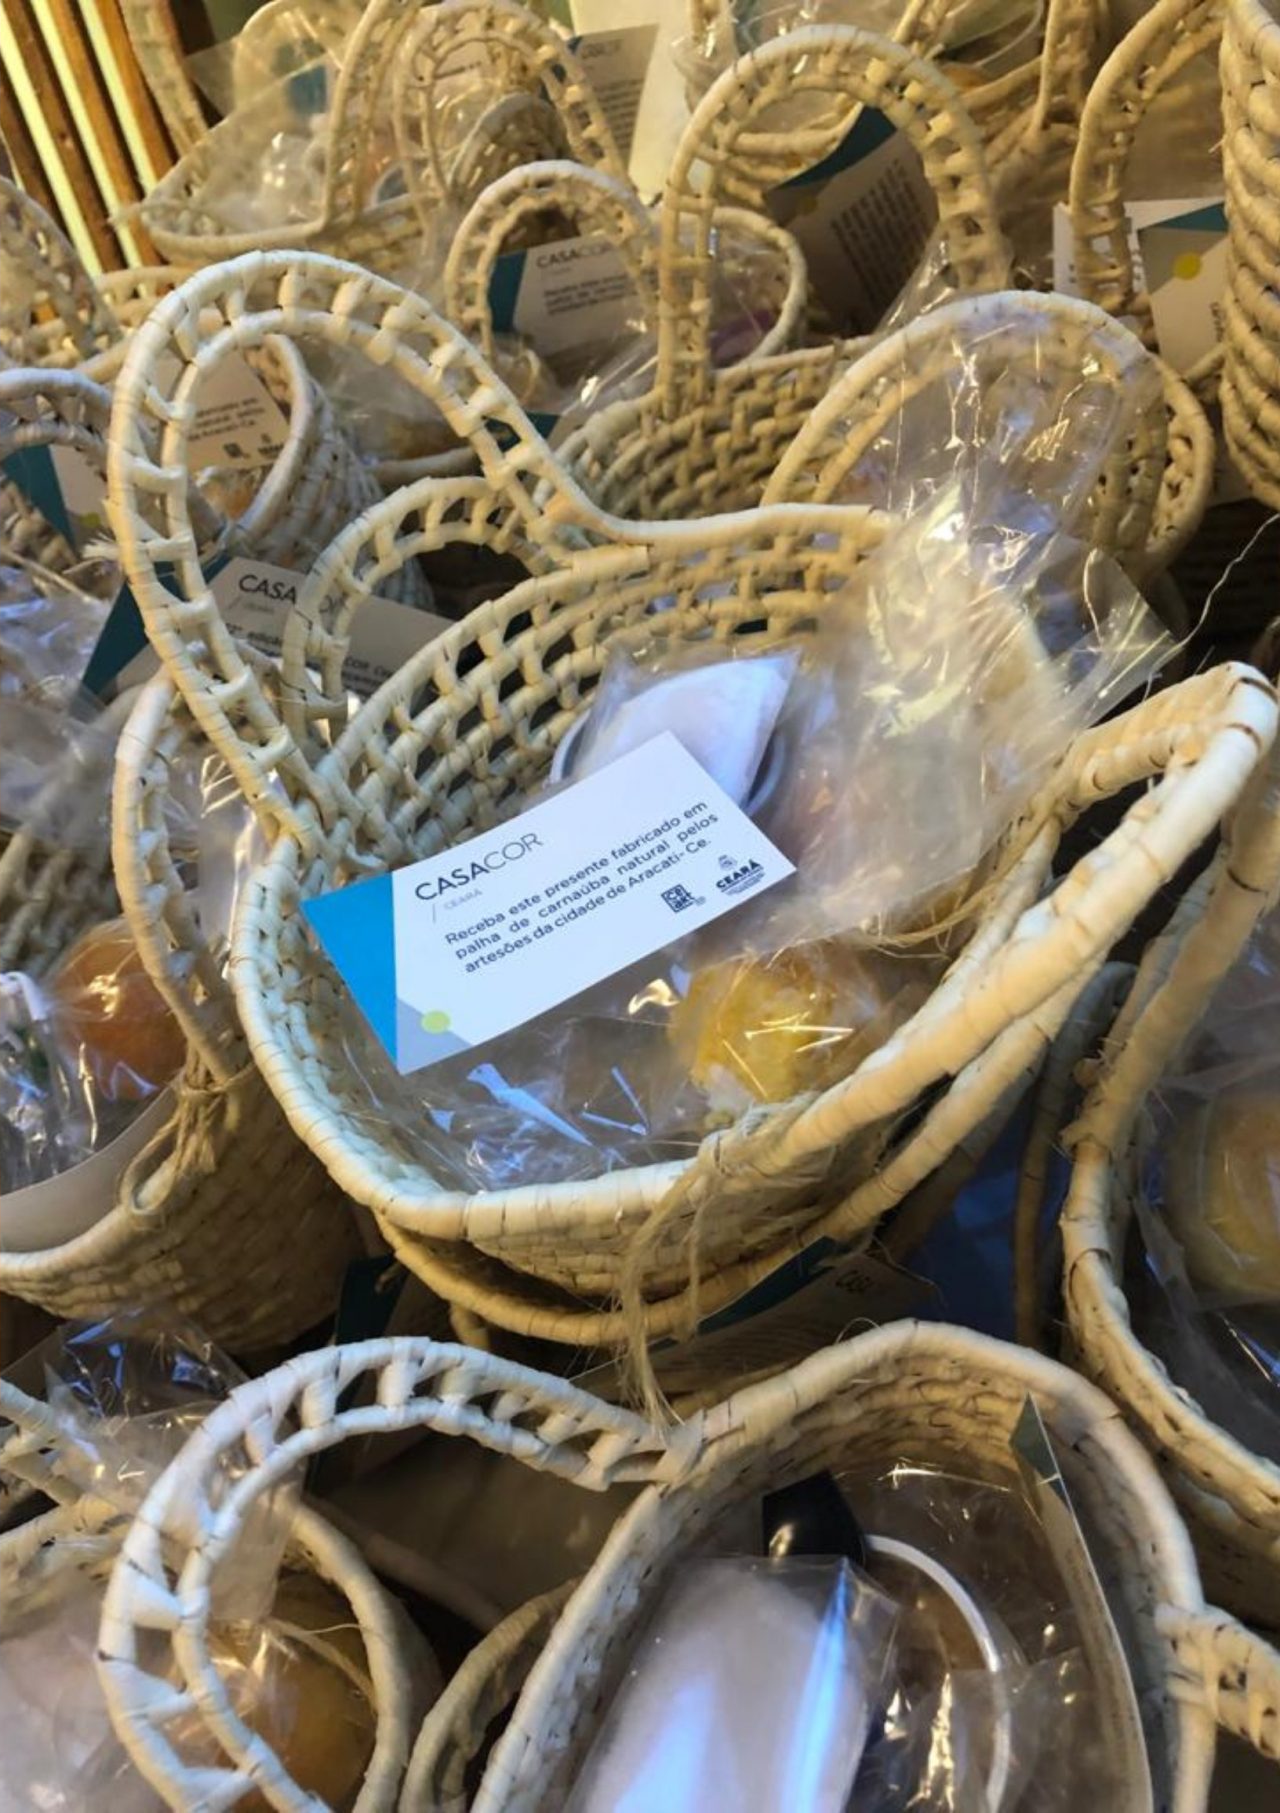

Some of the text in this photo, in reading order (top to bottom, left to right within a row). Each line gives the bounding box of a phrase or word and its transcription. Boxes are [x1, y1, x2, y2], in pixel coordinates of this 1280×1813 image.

[415, 832, 544, 900] CASACOR
[445, 801, 708, 944] Receba este presente fabricado em
[455, 813, 719, 960] palha de carnaúba natural pelos
[465, 934, 533, 973] artesões
[532, 923, 554, 940] da
[554, 893, 606, 927] cidade
[605, 883, 627, 900] de
[685, 837, 712, 855] Ce.
